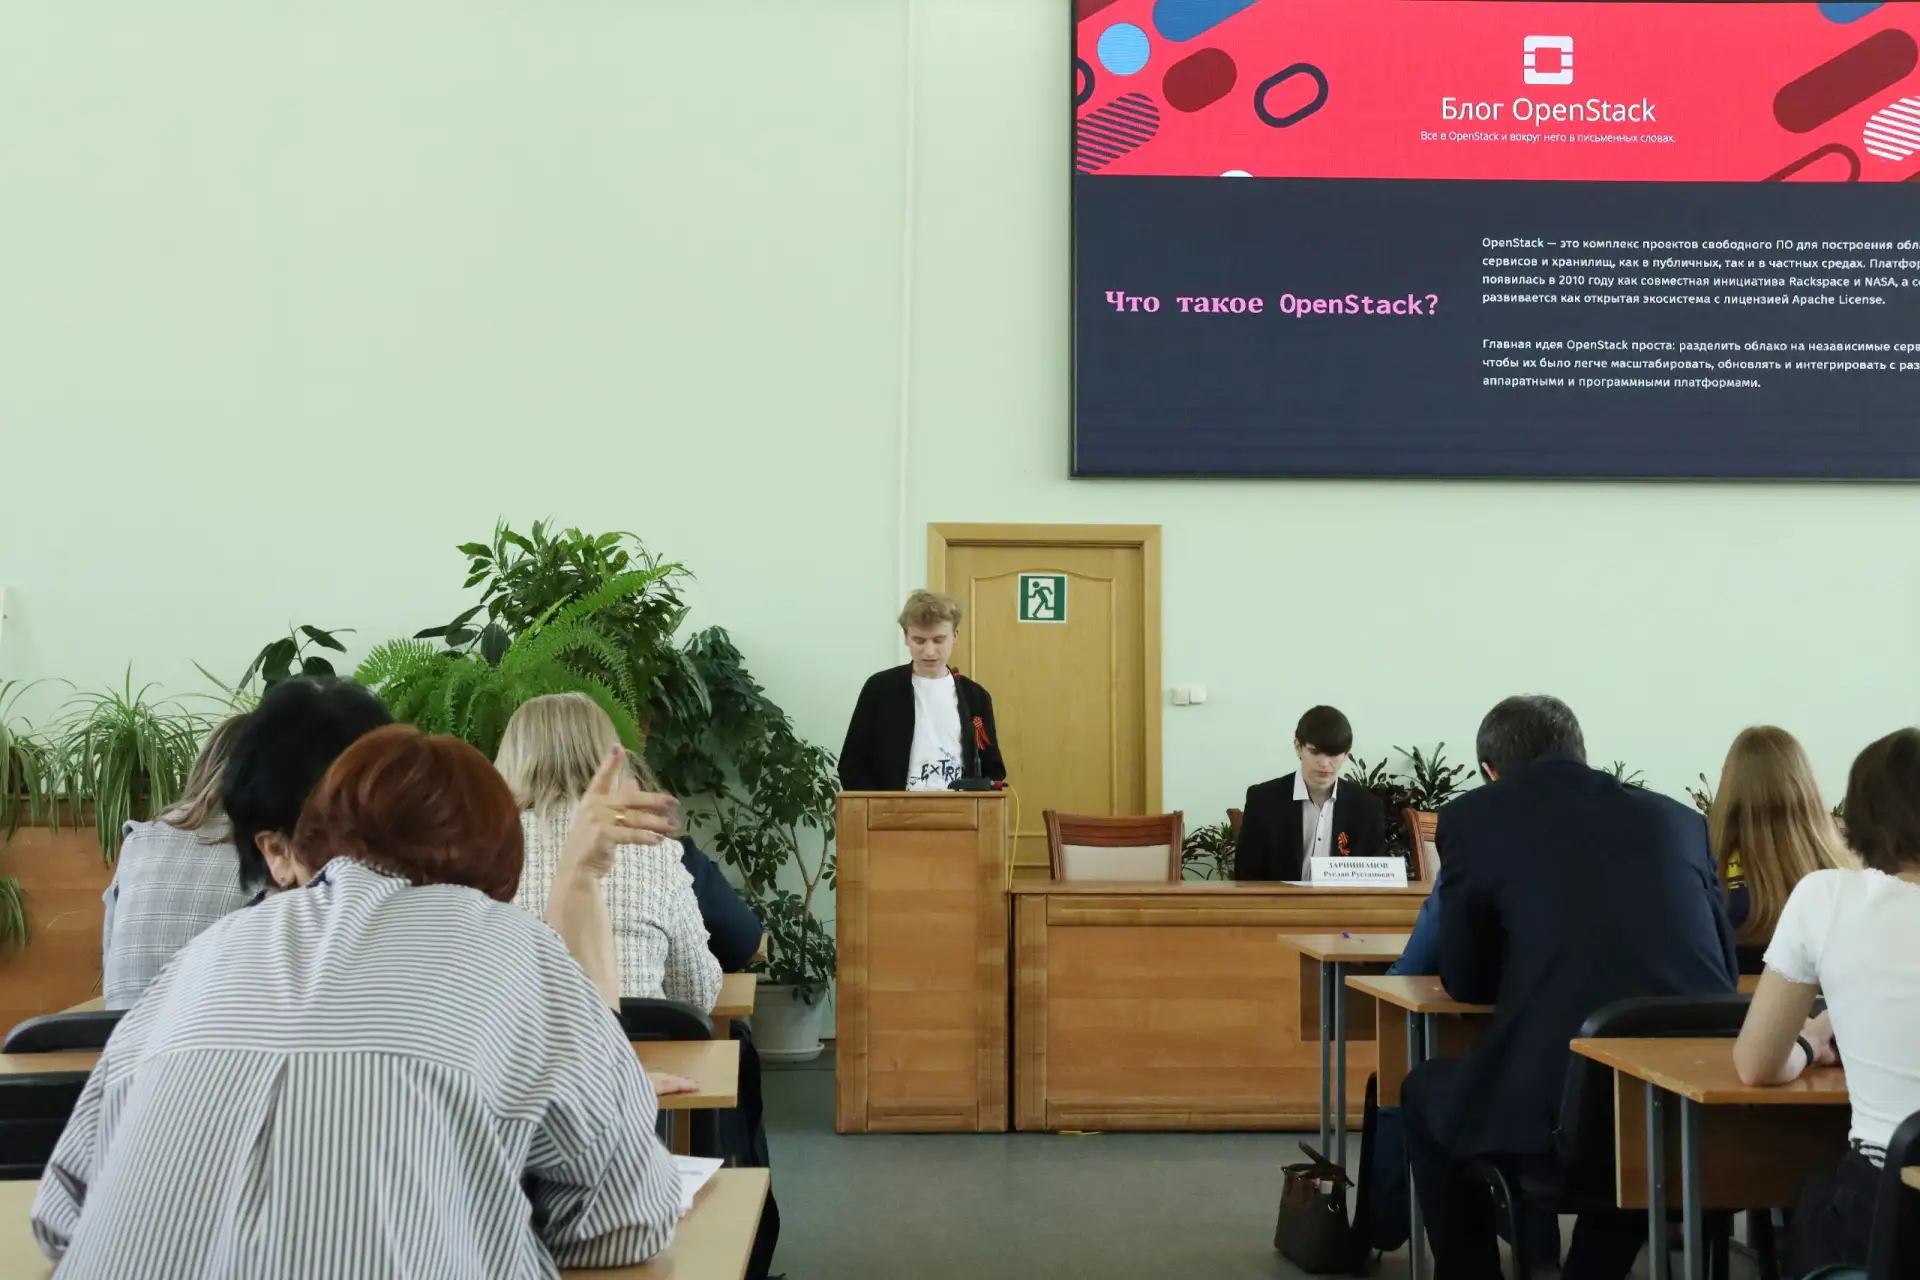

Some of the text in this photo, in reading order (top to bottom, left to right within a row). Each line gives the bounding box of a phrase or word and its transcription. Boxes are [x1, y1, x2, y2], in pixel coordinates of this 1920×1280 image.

[1442, 96, 1657, 127] Блог OpenStack
[1420, 130, 1676, 144] Все в OpenStack и вокруг него в письменных словах.
[1482, 237, 1544, 250] OpenStack
[1559, 240, 1580, 249] это
[1582, 240, 1640, 249] комплекс
[1642, 240, 1699, 252] проектов
[1701, 239, 1773, 251] свободного
[1776, 239, 1794, 250] ПО
[1795, 241, 1818, 252] для
[1821, 241, 1893, 253] построения
[1896, 240, 1920, 250] обл
[1482, 257, 1538, 268] сервисов
[1541, 258, 1549, 267] и
[1551, 258, 1616, 269] хранилищ,
[1619, 259, 1640, 268] как
[1642, 259, 1650, 268] в
[1652, 256, 1722, 270] публичных,
[1724, 259, 1745, 268] так
[1747, 260, 1755, 268] и
[1758, 259, 1766, 268] в
[1768, 259, 1819, 269] частных
[1821, 259, 1866, 270] средах.
[1482, 275, 1546, 285] появилась
[1548, 276, 1556, 285] в
[1558, 274, 1585, 286] 2010
[1588, 276, 1615, 288] году
[1617, 276, 1638, 286] как
[1640, 277, 1710, 287] совместная
[1713, 277, 1786, 288] инициатива
[1789, 276, 1850, 289] Rackspace
[1853, 278, 1861, 287] и
[1864, 277, 1899, 288] NASA,
[1900, 278, 1909, 288] а
[1104, 290, 1439, 319] Что такое OpenStack?
[1482, 293, 1886, 307] развивается как открытая экосистема с лицензией Apache License.
[1482, 338, 1920, 354] Главная идея OpenStack проста: разделить облако на независимые серв
[1482, 356, 1920, 373] чтобы их было легче масштабировать, обновлять и интегрировать с раз
[1482, 376, 1761, 390] аппаратными и программными платформами.
